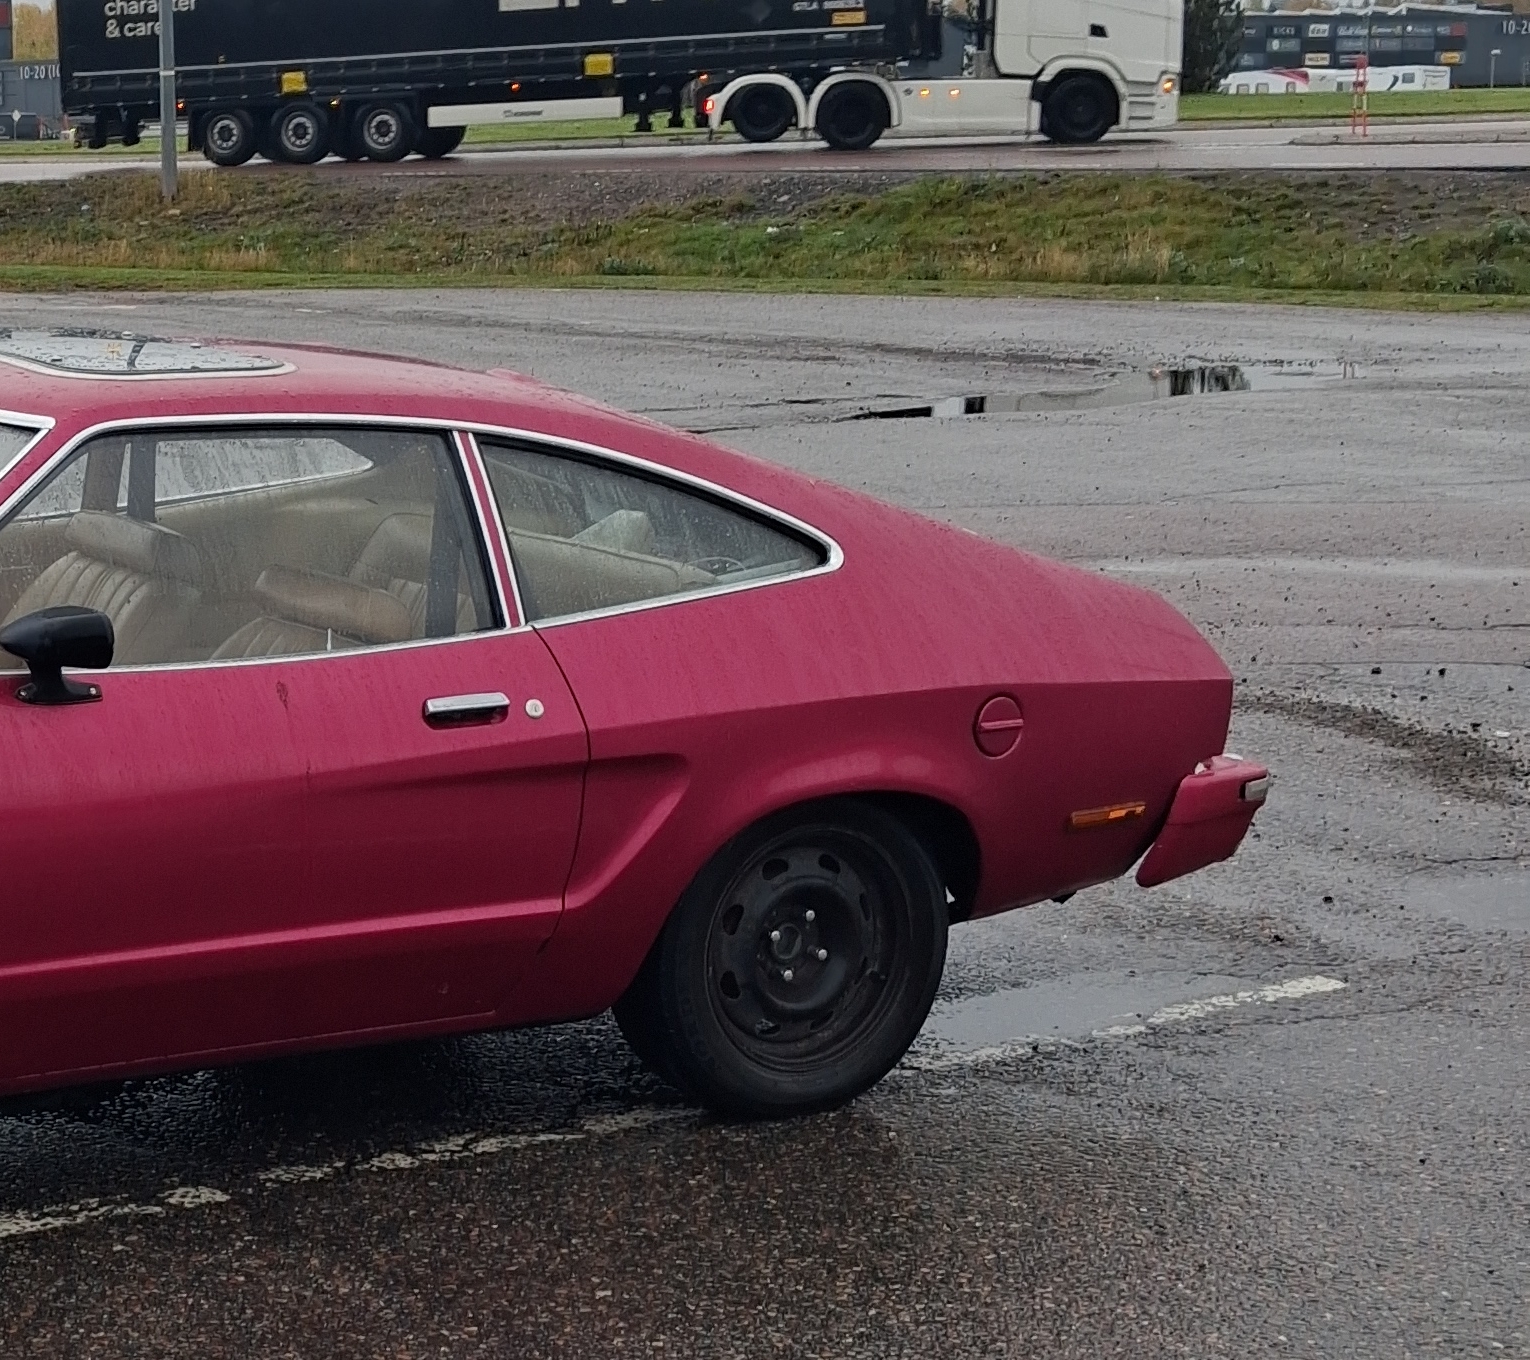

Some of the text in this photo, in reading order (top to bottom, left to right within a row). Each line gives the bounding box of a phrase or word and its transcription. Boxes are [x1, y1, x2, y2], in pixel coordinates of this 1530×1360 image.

[105, 19, 162, 38] & care
[1502, 20, 1530, 35] 10-2
